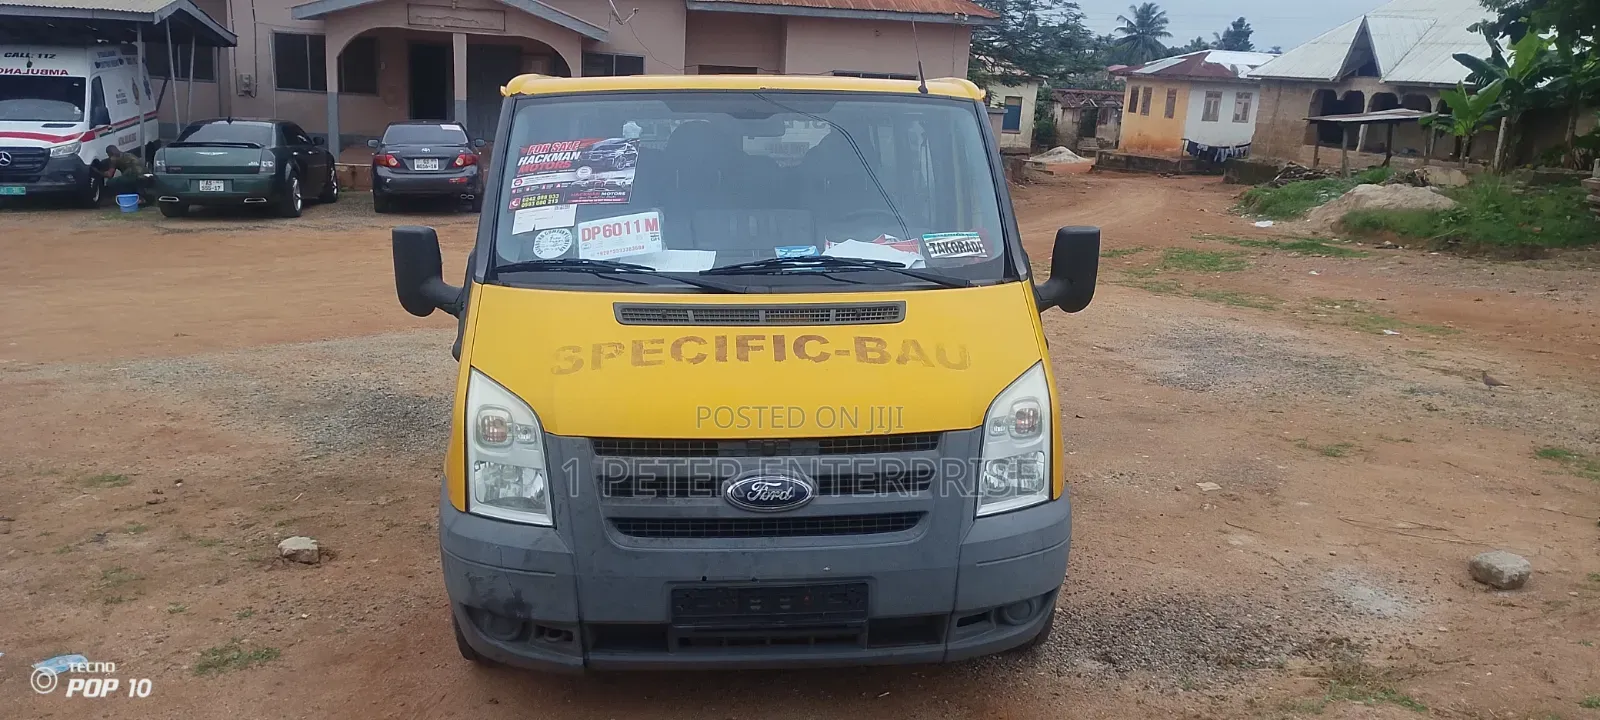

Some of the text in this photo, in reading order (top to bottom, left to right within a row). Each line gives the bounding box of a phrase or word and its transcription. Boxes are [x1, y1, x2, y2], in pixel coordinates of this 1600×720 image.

[527, 141, 581, 156] FOR SALE
[518, 151, 581, 166] HACKMAN
[518, 160, 572, 173] MOTORS
[644, 217, 659, 232] M
[928, 241, 983, 255] TAKORADI
[551, 334, 971, 375] SPECIFIC-BAU
[747, 481, 794, 502] Ford
